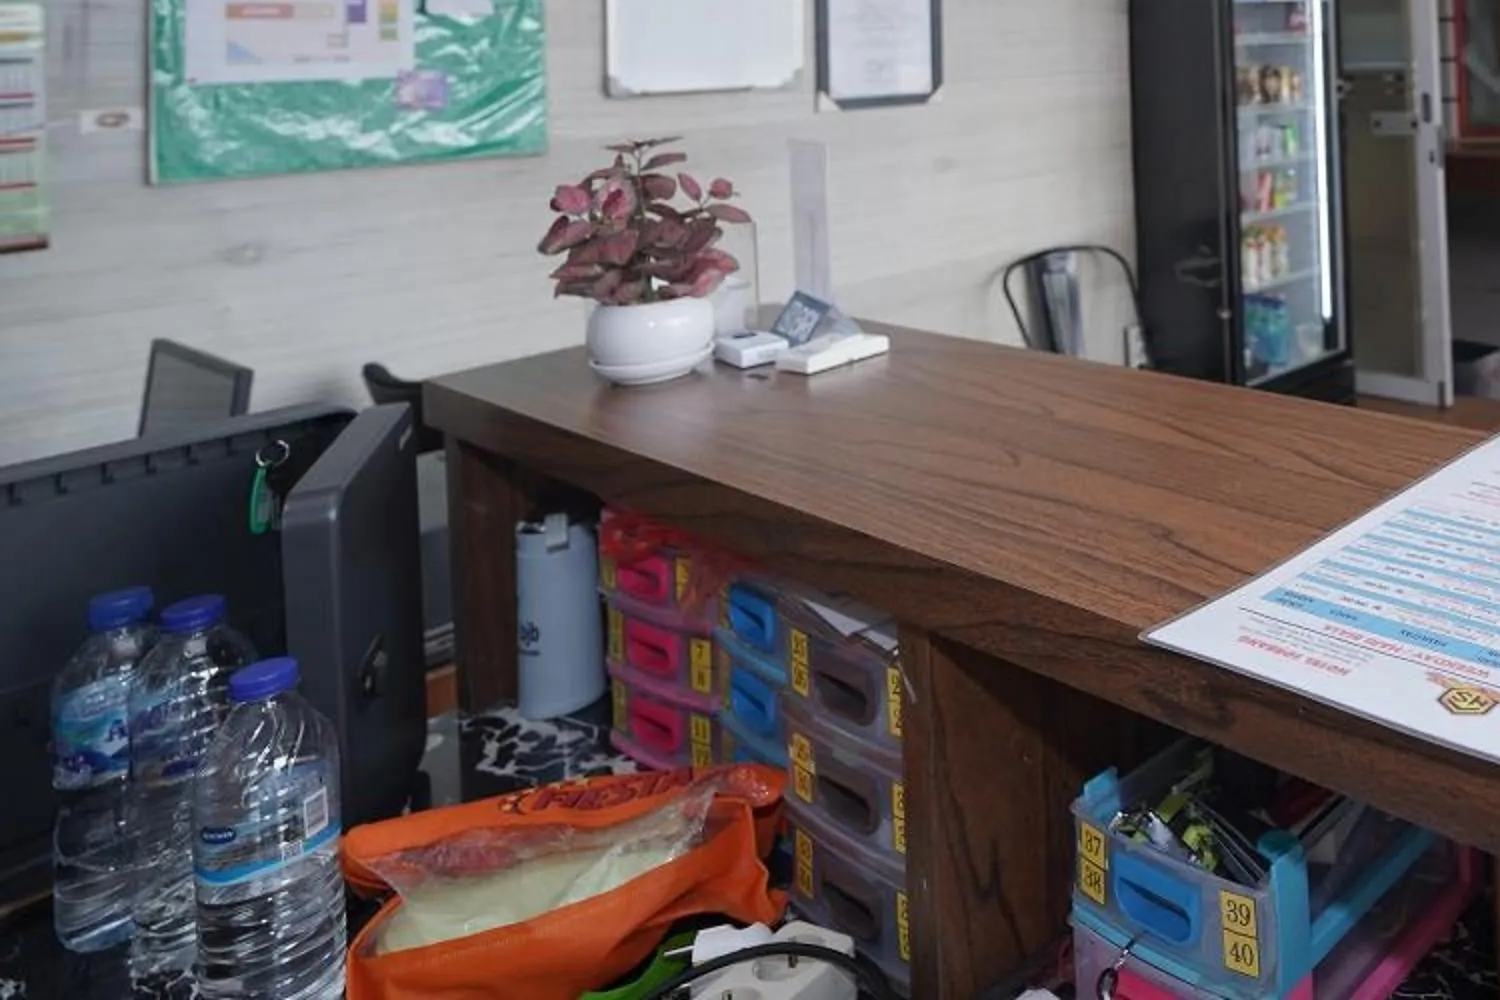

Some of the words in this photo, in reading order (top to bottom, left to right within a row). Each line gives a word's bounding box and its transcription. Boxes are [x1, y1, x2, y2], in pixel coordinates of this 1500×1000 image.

[1084, 827, 1102, 855] 37
[1226, 898, 1251, 928] 39
[1228, 943, 1255, 967] 40
